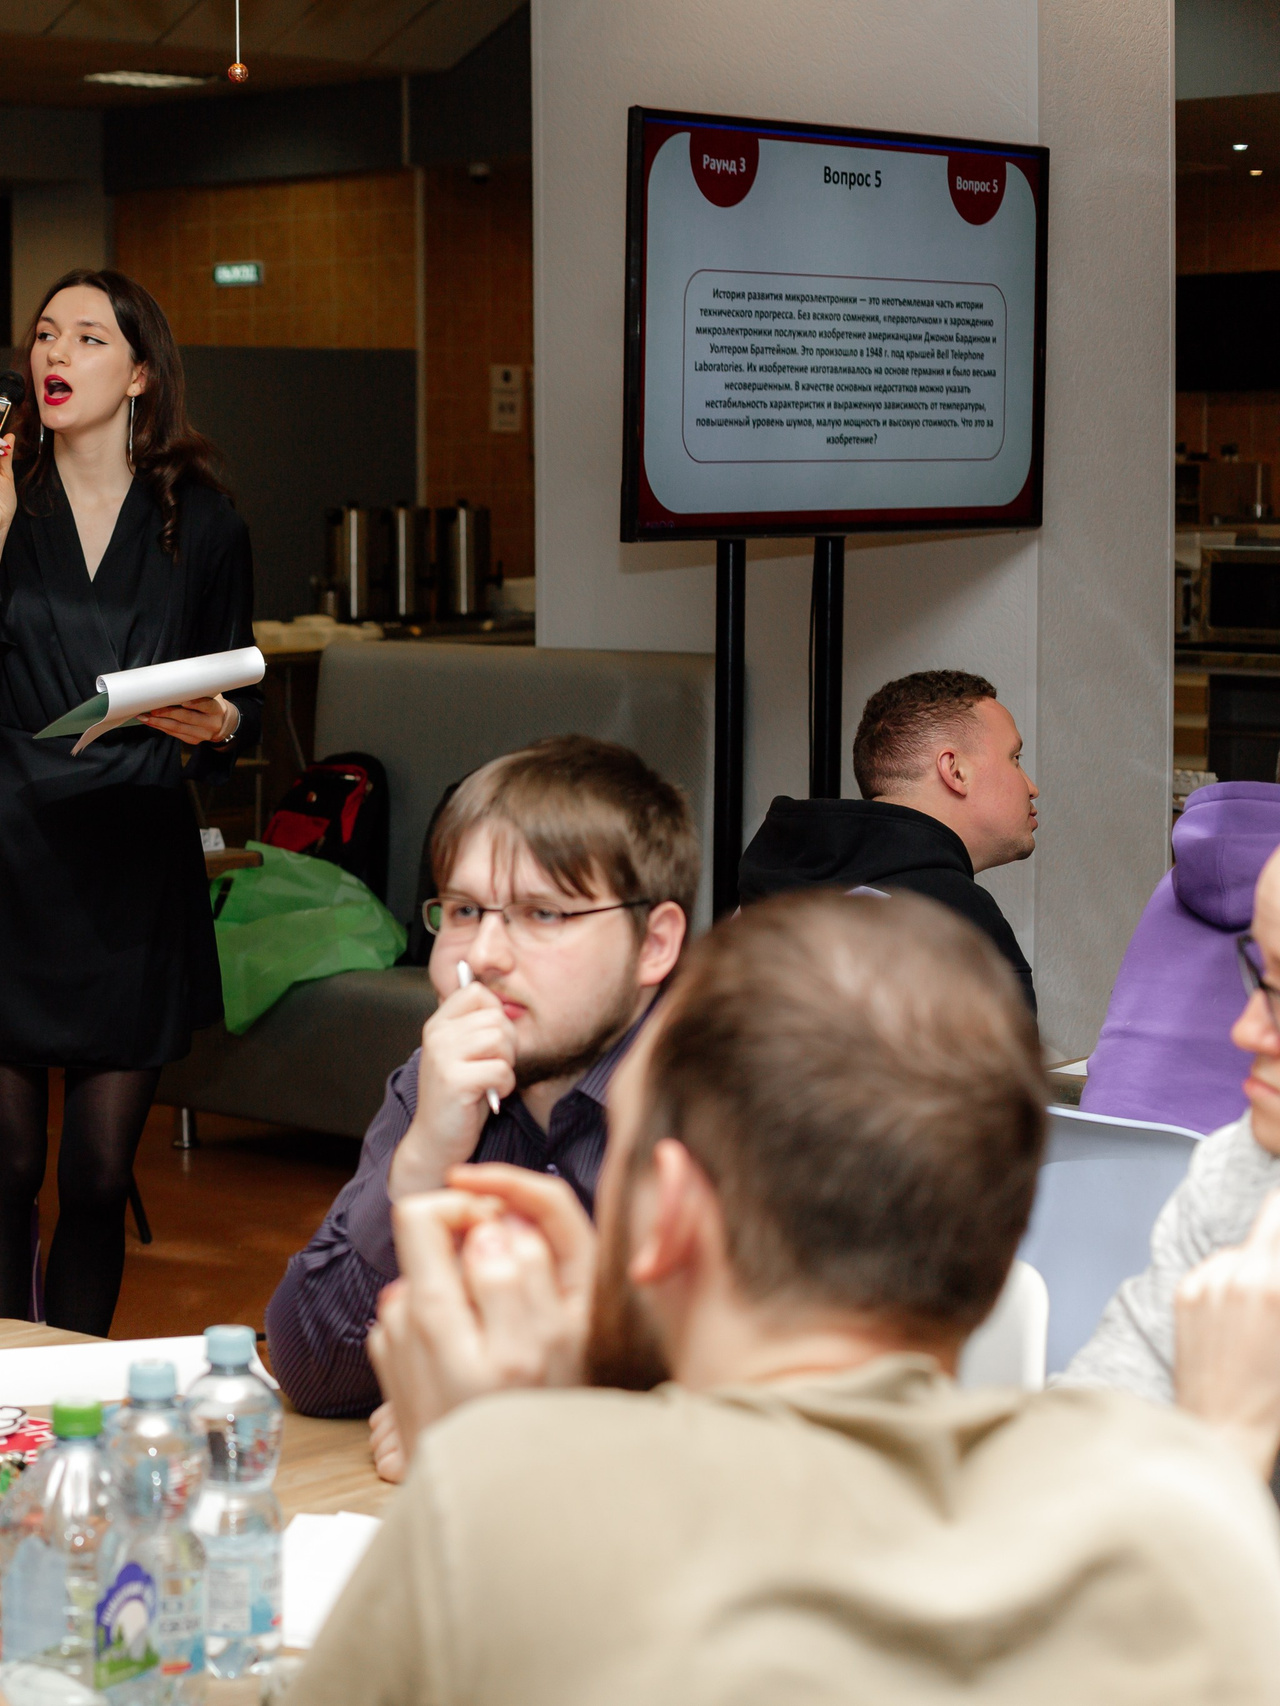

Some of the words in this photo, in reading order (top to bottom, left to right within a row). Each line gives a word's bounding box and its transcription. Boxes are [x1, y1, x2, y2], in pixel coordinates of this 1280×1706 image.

[703, 154, 736, 175] Раунд
[739, 157, 745, 172] 3
[824, 165, 870, 190] Вопрос
[874, 170, 881, 187] 5
[956, 176, 990, 194] Вопрос
[992, 179, 998, 193] 5
[712, 288, 745, 301] История
[747, 291, 782, 302] развития
[784, 293, 857, 305] микроэлектроники
[868, 297, 880, 305] это
[881, 297, 934, 307] неотъемлемая
[936, 300, 954, 308] часть
[956, 301, 983, 311] истории
[700, 308, 752, 318] технического
[754, 310, 795, 321] прогресса.
[797, 309, 810, 320] Без
[812, 312, 840, 321] всякого
[842, 313, 880, 324] сомнения,
[883, 315, 942, 325] «первотолчком»
[950, 317, 993, 327] зарождению
[695, 326, 772, 338] микроэлектроники
[774, 329, 816, 339] послужило
[818, 327, 866, 341] изобретение
[868, 331, 922, 342] американцами
[924, 331, 953, 343] Джоном
[955, 332, 990, 344] Бардином
[709, 343, 748, 356] Уолтером
[750, 343, 798, 356] Браттейном.
[801, 345, 813, 355] Это
[816, 348, 858, 358] произошло
[860, 349, 864, 357] в
[866, 347, 882, 357] 1948
[884, 349, 888, 357] г.
[891, 350, 904, 360] под
[906, 348, 934, 360] крышей
[936, 349, 948, 359] Bell
[950, 349, 984, 361] Telephone
[694, 360, 744, 372] Laboratories.
[746, 362, 756, 372] Их
[758, 362, 808, 375] изобретение
[810, 365, 872, 374] изготавливалось
[874, 366, 882, 374] на
[884, 367, 909, 375] основе
[911, 368, 944, 377] германия
[952, 365, 970, 376] было
[972, 369, 996, 377] весьма
[724, 382, 792, 392] несовершенным.
[794, 380, 799, 391] В
[801, 383, 834, 391] качестве
[836, 383, 871, 392] основных
[874, 384, 917, 394] недостатков
[919, 385, 943, 393] можно
[945, 385, 970, 395] указать
[705, 397, 767, 408] нестабильность
[769, 400, 824, 410] характеристик
[833, 401, 882, 411] выраженную
[884, 401, 928, 410] зависимость
[930, 402, 937, 410] от
[939, 402, 986, 412] температуры,
[696, 415, 750, 426] повышенный
[752, 418, 784, 428] уровень
[786, 418, 814, 428] шумов,
[816, 418, 841, 428] малую
[843, 418, 880, 428] мощность
[888, 418, 920, 429] высокую
[922, 419, 958, 427] стоимость.
[960, 418, 972, 427] Что
[974, 419, 984, 427] это
[986, 419, 993, 427] за
[826, 433, 877, 446] изобретение?
